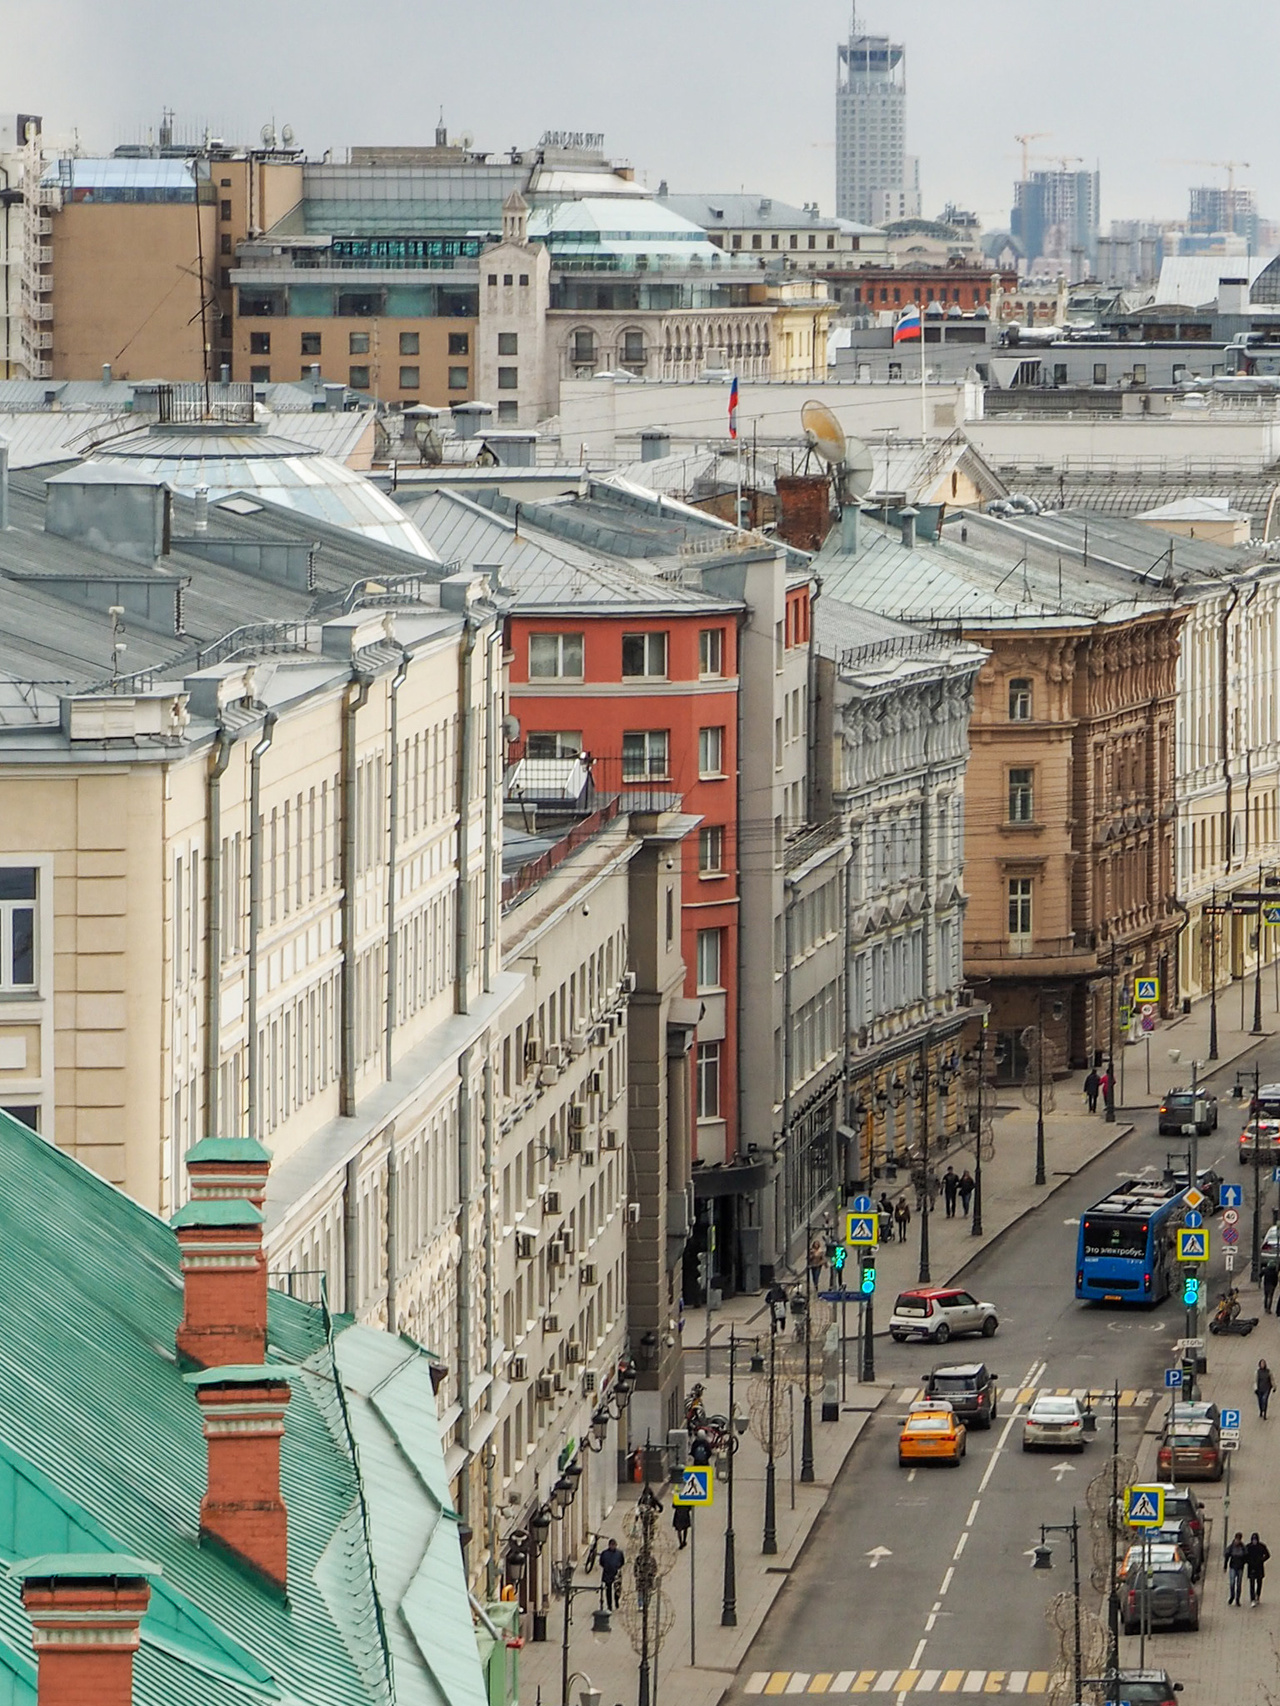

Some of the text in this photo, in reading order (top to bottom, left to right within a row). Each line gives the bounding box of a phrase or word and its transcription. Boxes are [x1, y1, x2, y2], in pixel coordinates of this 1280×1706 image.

[1225, 1212, 1236, 1220] 40
[1085, 1246, 1100, 1254] Это
[1169, 1371, 1180, 1385] P
[1226, 1411, 1237, 1426] P
